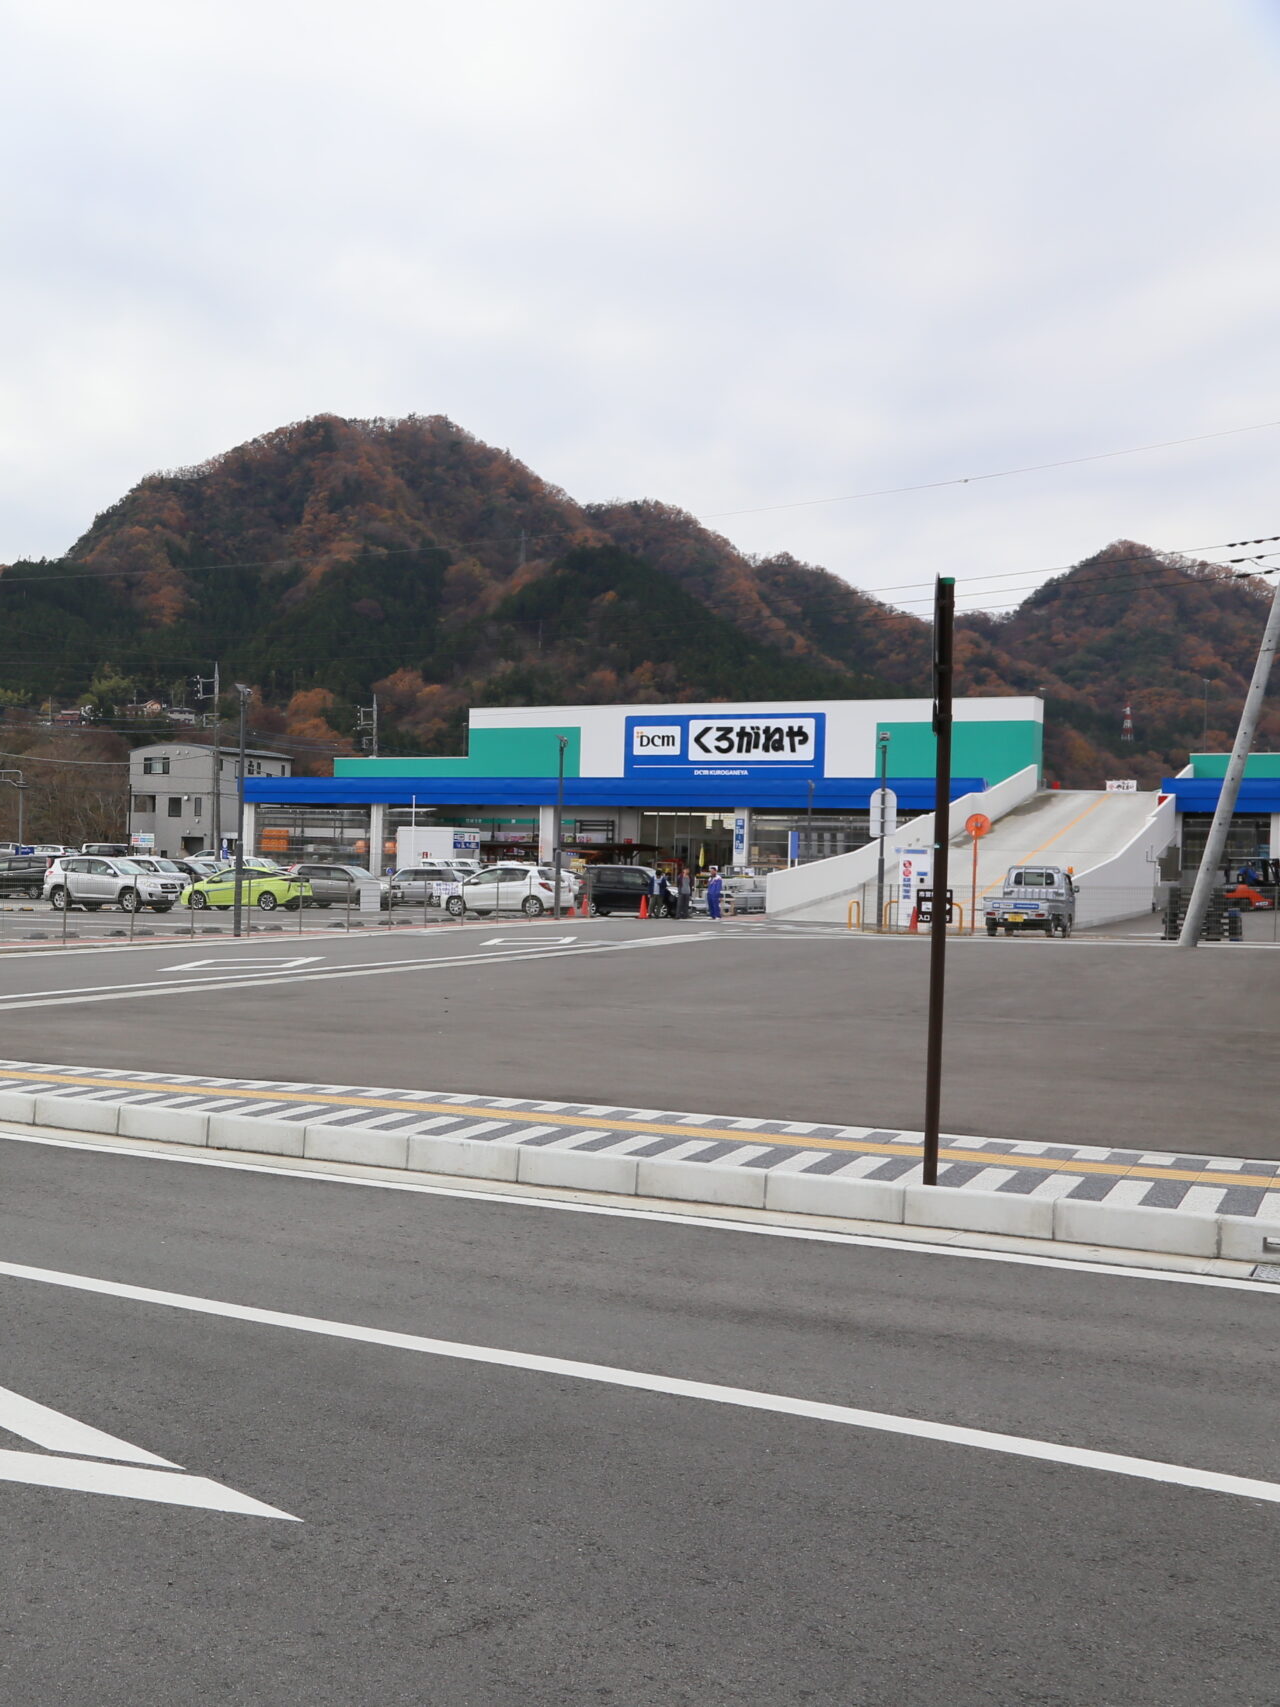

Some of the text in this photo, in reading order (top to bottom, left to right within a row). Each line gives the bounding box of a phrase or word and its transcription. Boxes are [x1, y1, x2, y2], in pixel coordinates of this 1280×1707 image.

[693, 725, 809, 754] くろがねや
